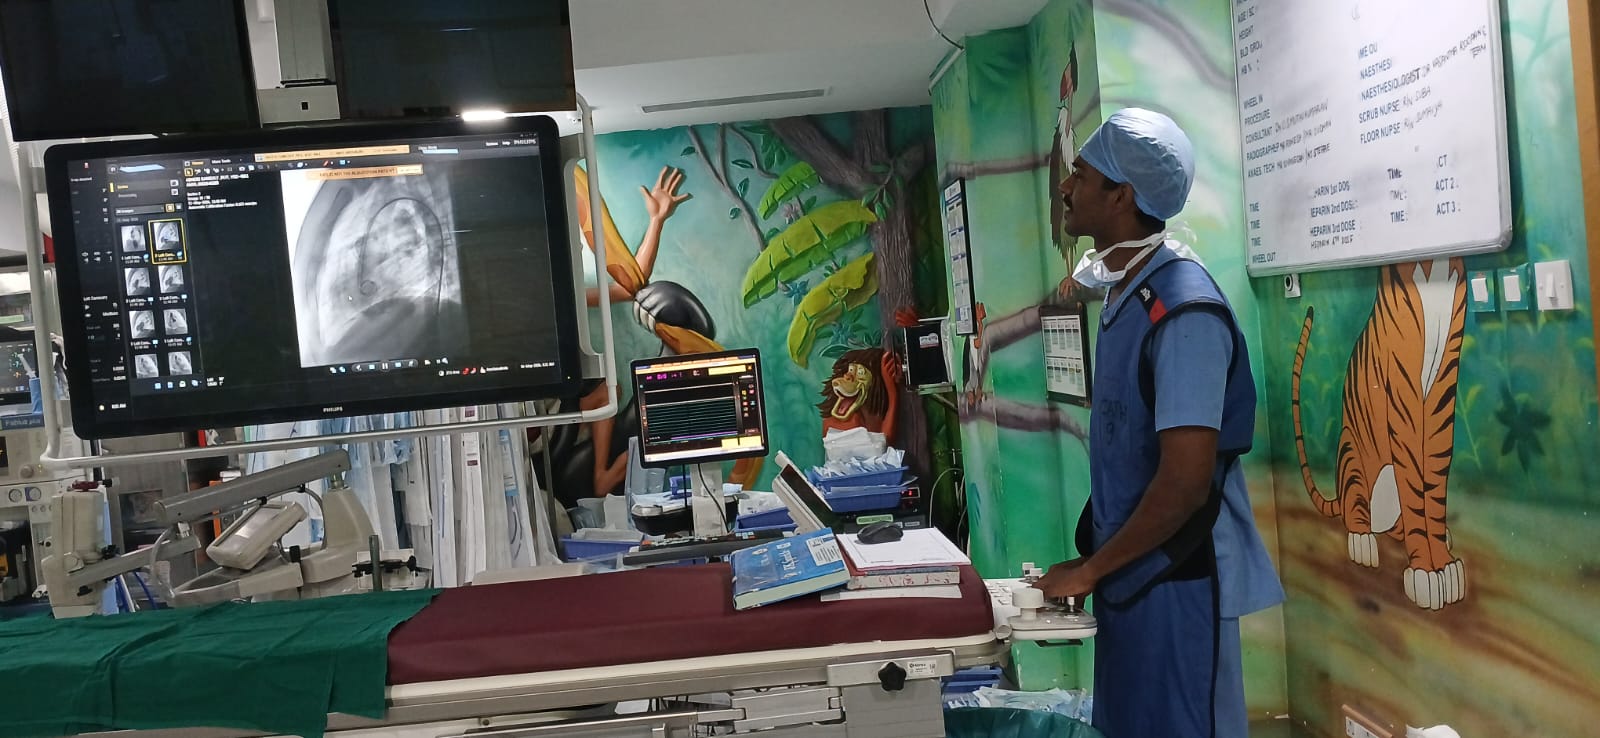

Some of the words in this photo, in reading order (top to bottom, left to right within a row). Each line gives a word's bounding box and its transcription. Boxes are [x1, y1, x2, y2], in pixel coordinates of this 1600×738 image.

[1359, 107, 1379, 124] SCRUB
[1380, 99, 1400, 117] NURSE
[1360, 129, 1379, 144] FLOOR
[1380, 122, 1401, 138] NURSE
[1435, 178, 1449, 191] ACT
[1437, 201, 1450, 215] ACT
